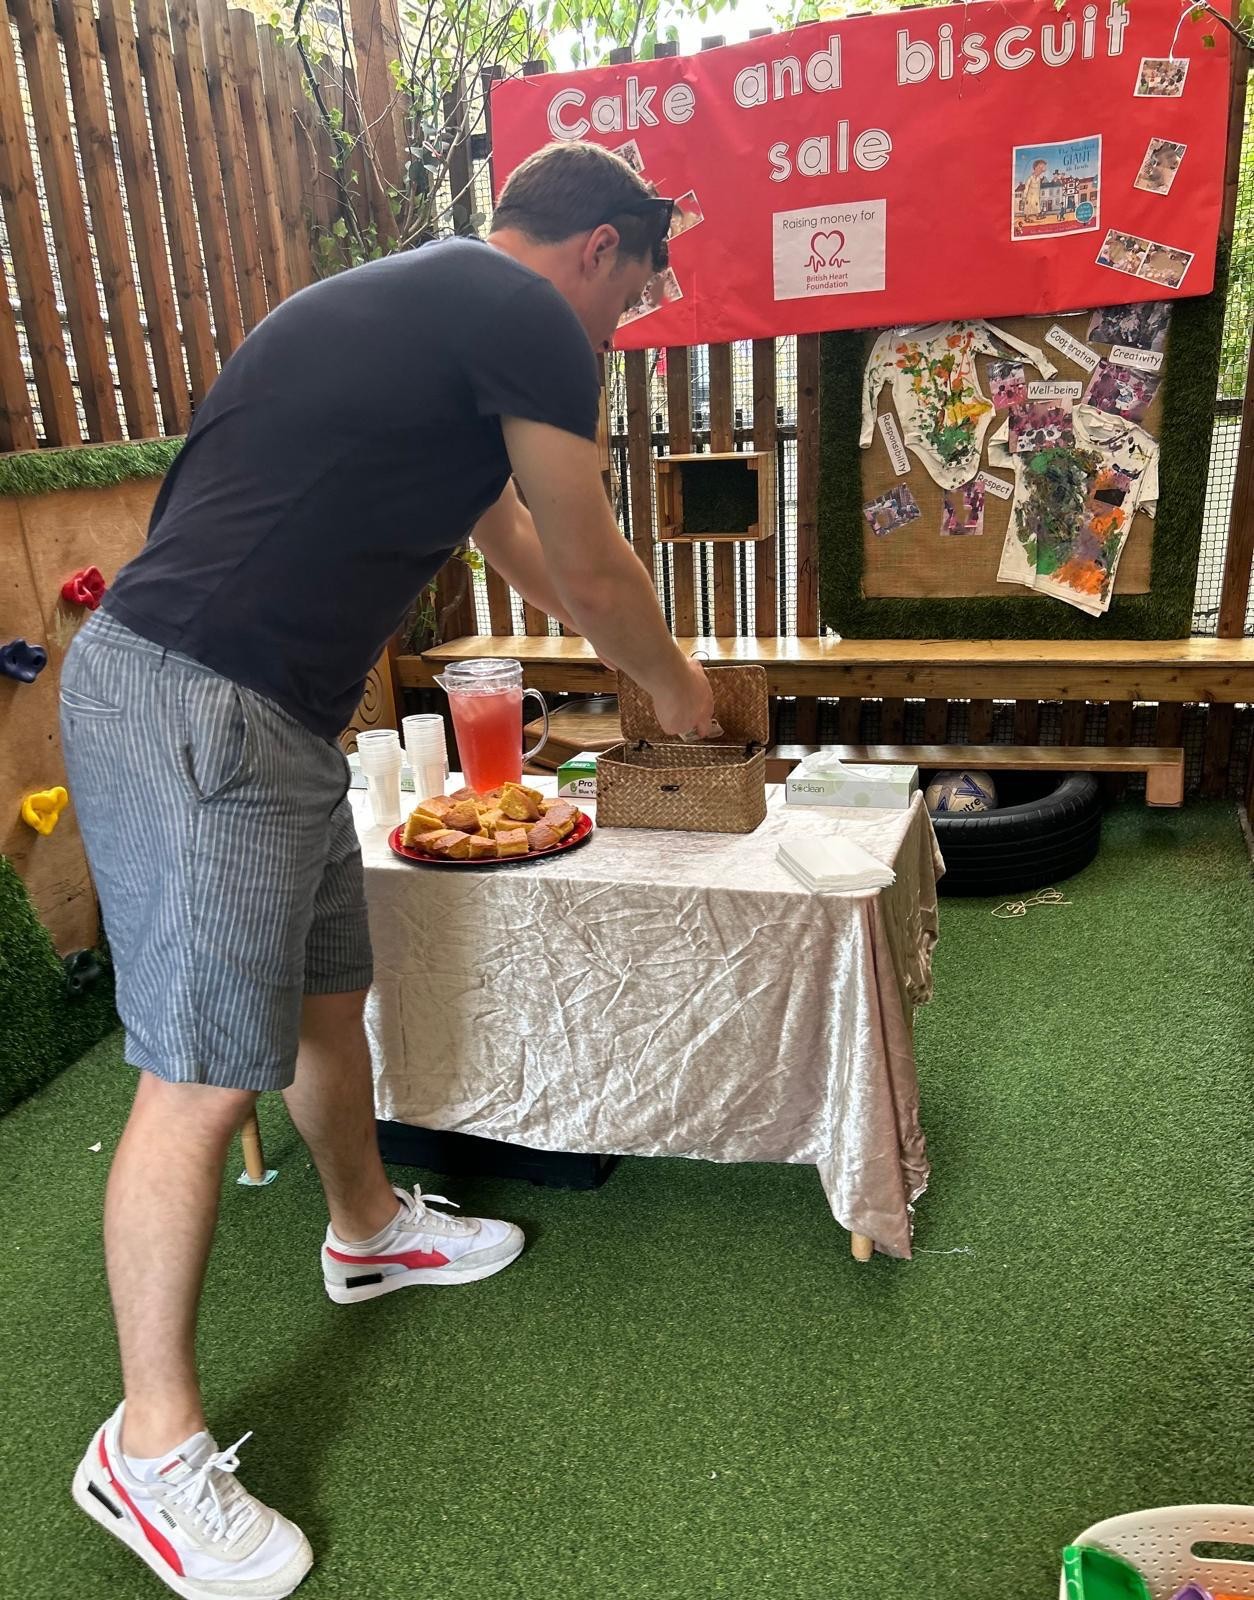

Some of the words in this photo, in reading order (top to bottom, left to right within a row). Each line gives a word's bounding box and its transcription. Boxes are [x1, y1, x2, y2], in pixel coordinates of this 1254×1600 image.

[547, 76, 696, 141] Cake
[733, 34, 842, 109] and
[897, 0, 1129, 85] biscuit
[767, 120, 892, 183] sale
[1063, 150, 1090, 166] GIANT
[782, 217, 818, 229] Raising
[820, 213, 858, 225] money
[860, 210, 876, 220] for
[806, 273, 828, 282] British
[829, 272, 848, 280] Heart
[806, 281, 849, 290] Foundation
[1050, 330, 1096, 367] Cooperation
[1112, 348, 1161, 366] Creativity
[1030, 385, 1079, 397] Well-being
[882, 414, 907, 472] Responsibility
